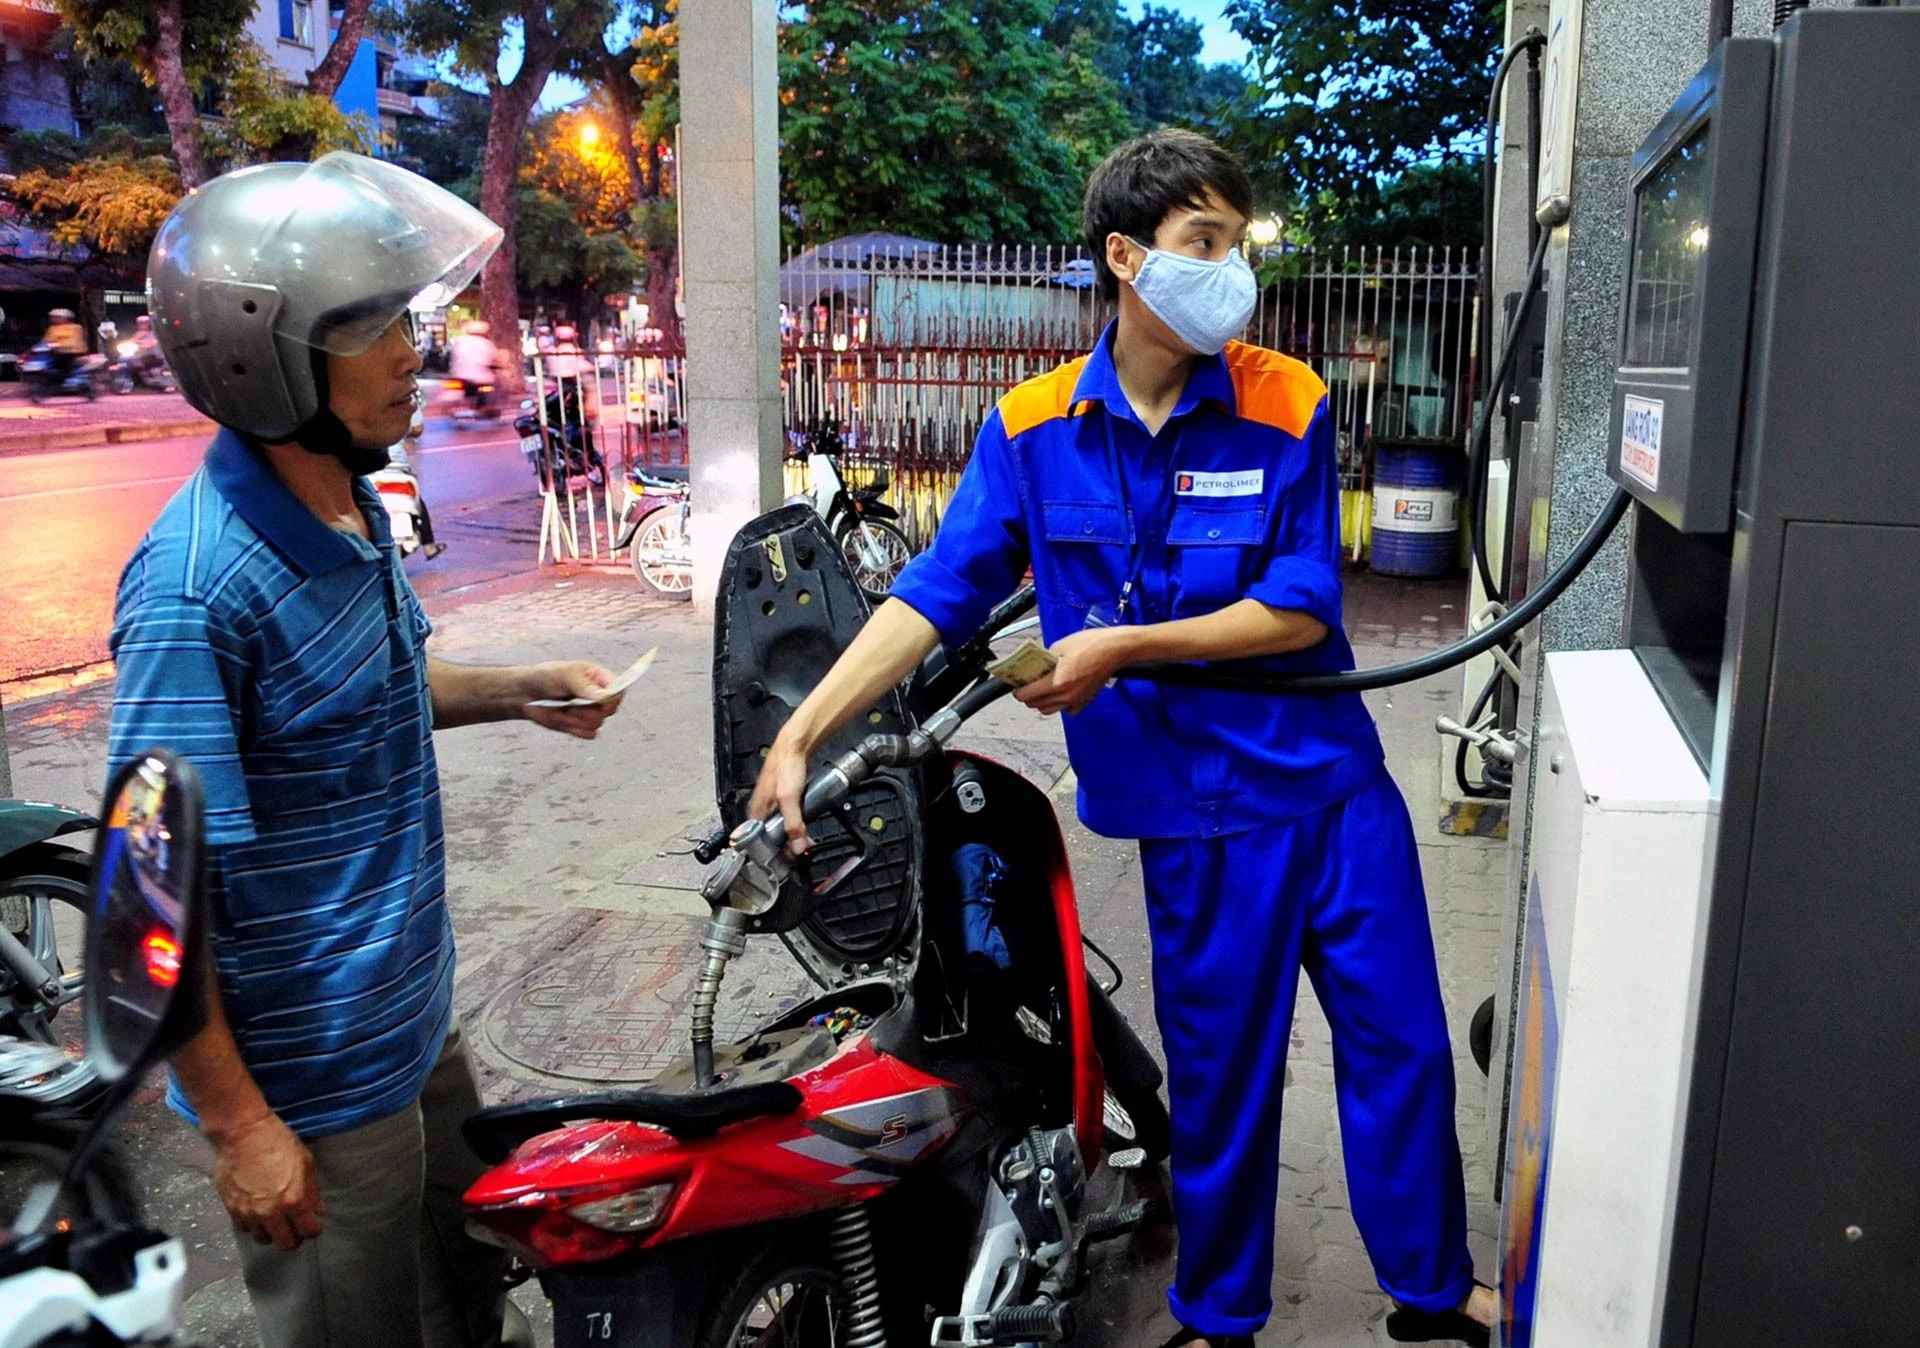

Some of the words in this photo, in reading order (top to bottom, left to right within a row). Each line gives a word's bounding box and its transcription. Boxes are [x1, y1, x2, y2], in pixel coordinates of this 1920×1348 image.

[1195, 478, 1260, 489] PETROLIMEX
[878, 1111, 908, 1149] S
[586, 1311, 612, 1339] T8
